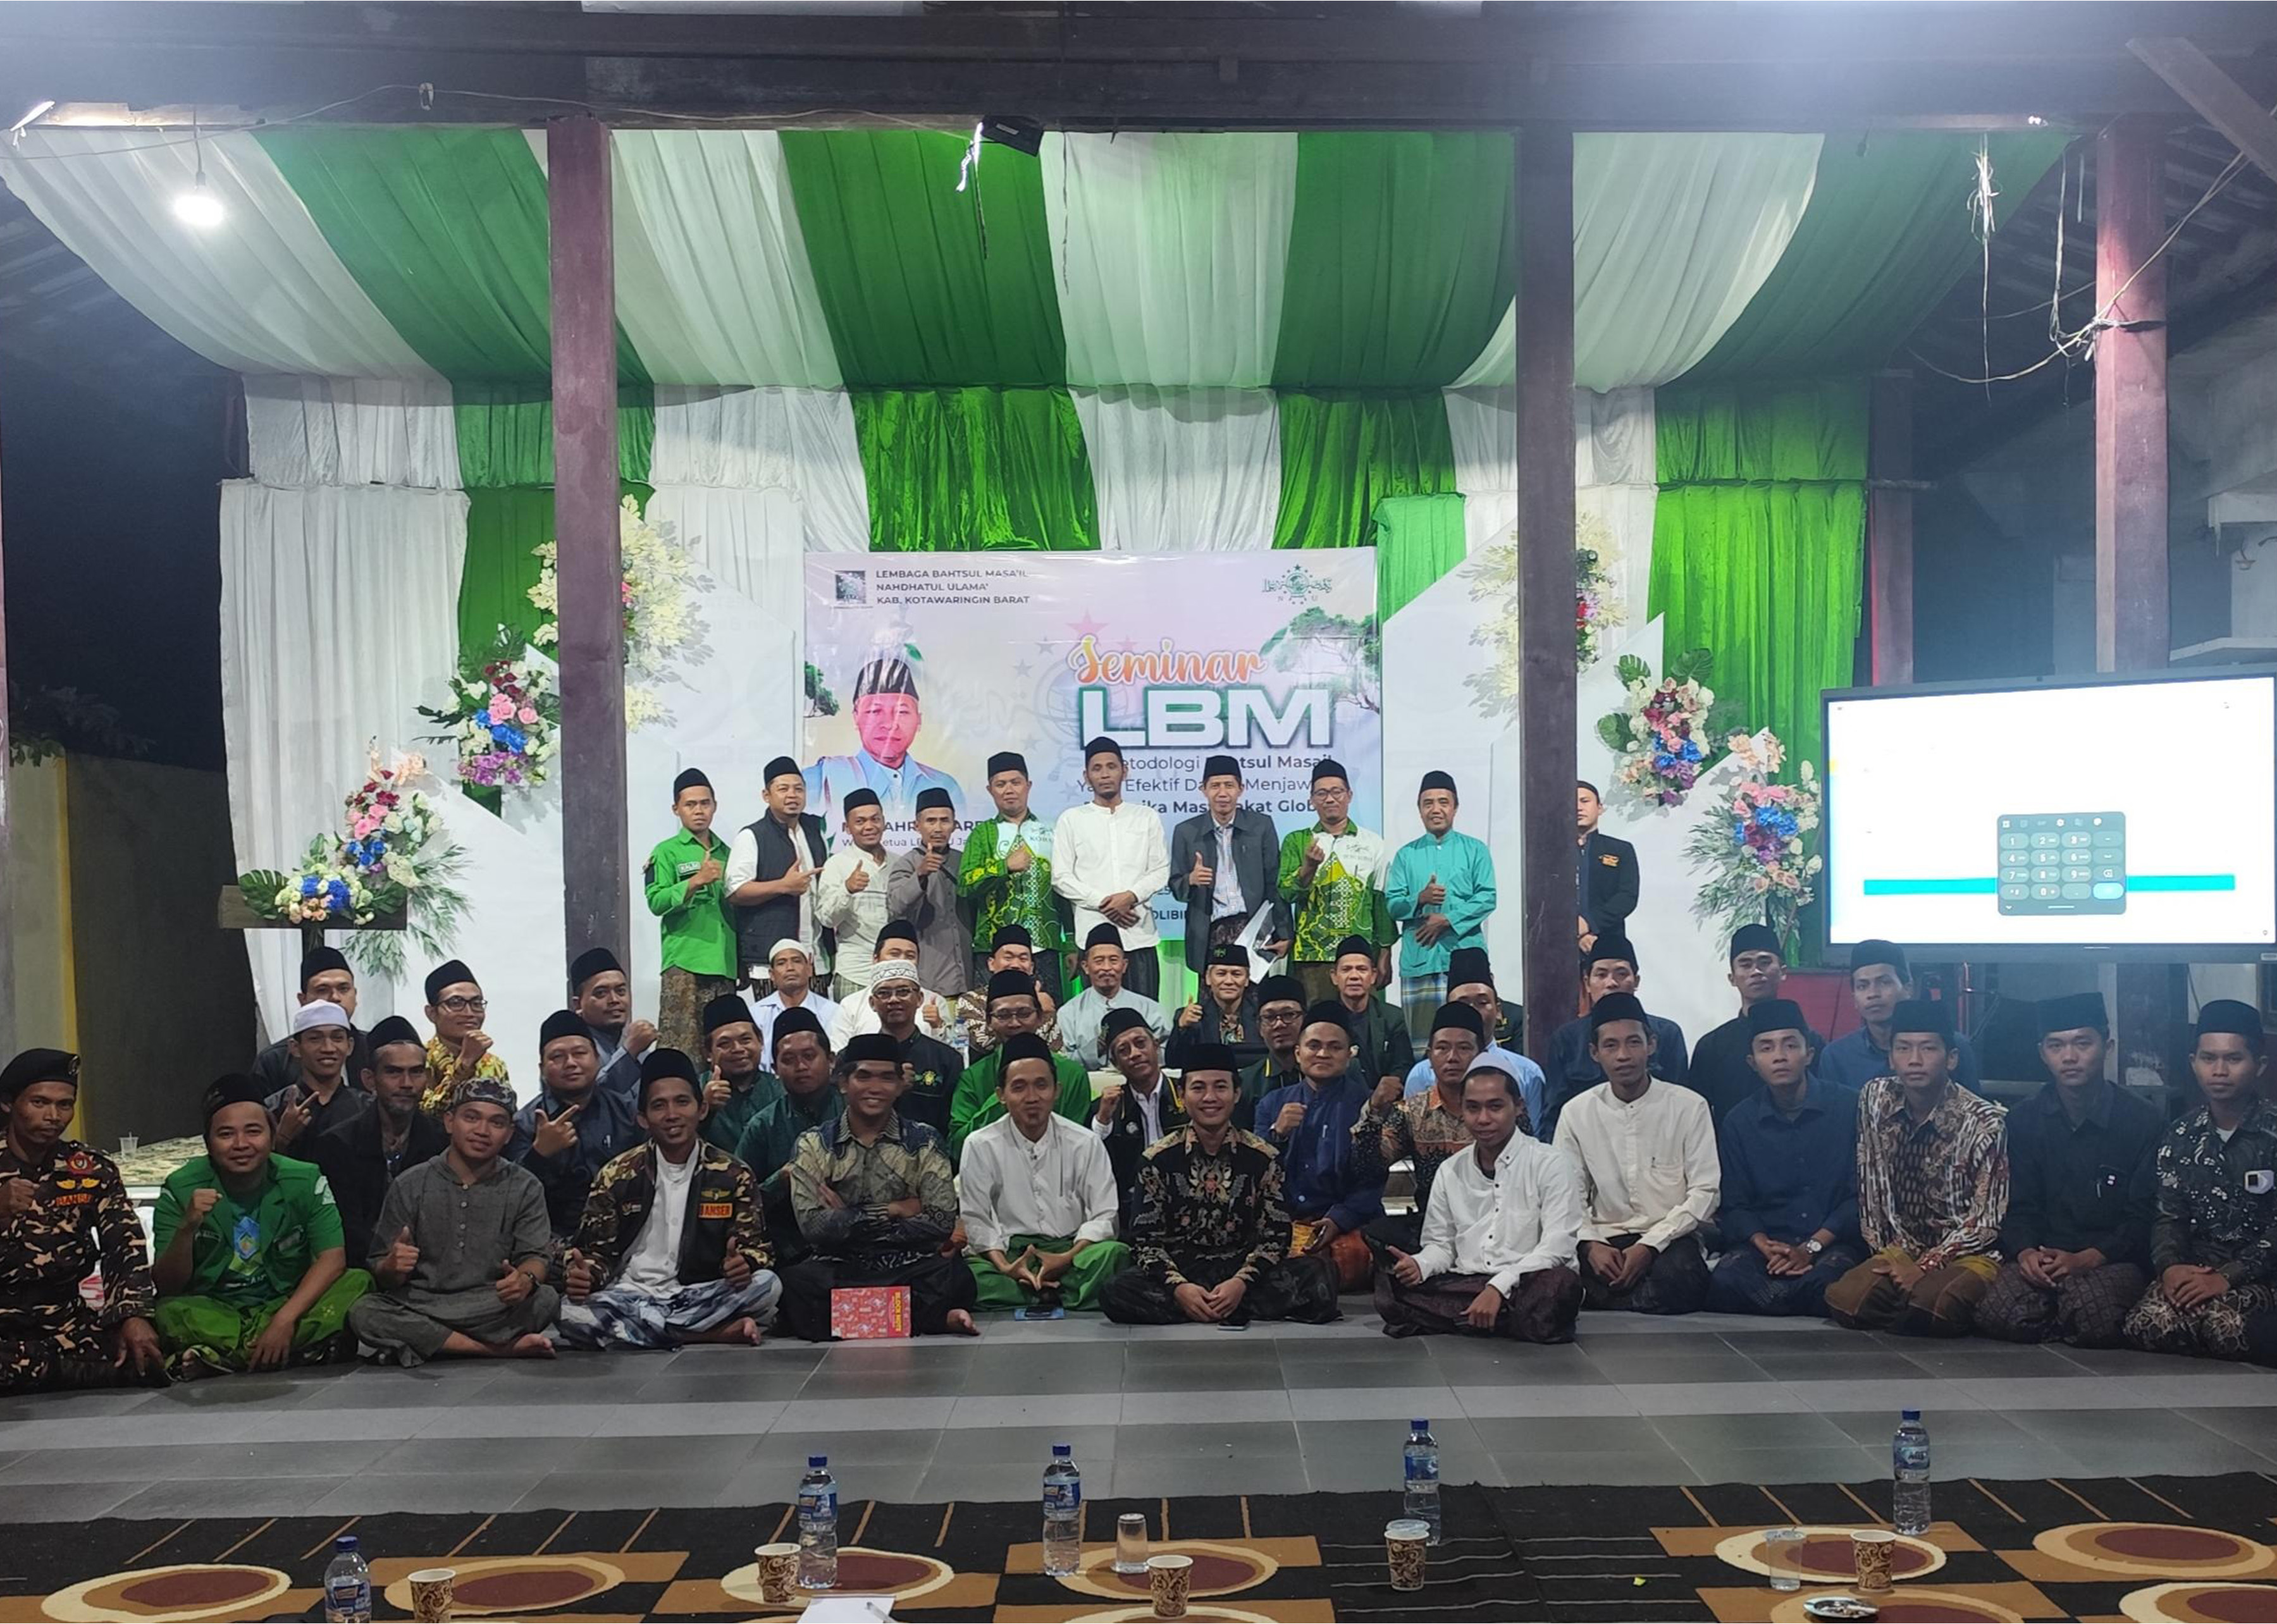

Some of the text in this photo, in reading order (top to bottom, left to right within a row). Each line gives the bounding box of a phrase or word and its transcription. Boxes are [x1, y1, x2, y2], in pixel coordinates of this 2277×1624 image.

[876, 570, 930, 578] LEMBAGA
[932, 570, 982, 578] BAHTSUL
[876, 583, 944, 591] NAHDHATUL
[904, 596, 990, 604] KOTAWARINGIN
[994, 596, 1030, 604] BARAT
[1068, 635, 1266, 684] Seminar
[1080, 688, 1331, 749] LBM
[1122, 755, 1200, 772] etodologi
[1240, 755, 1271, 768] tsul
[1126, 778, 1180, 791] Efektif
[1245, 777, 1312, 794] Menjaw
